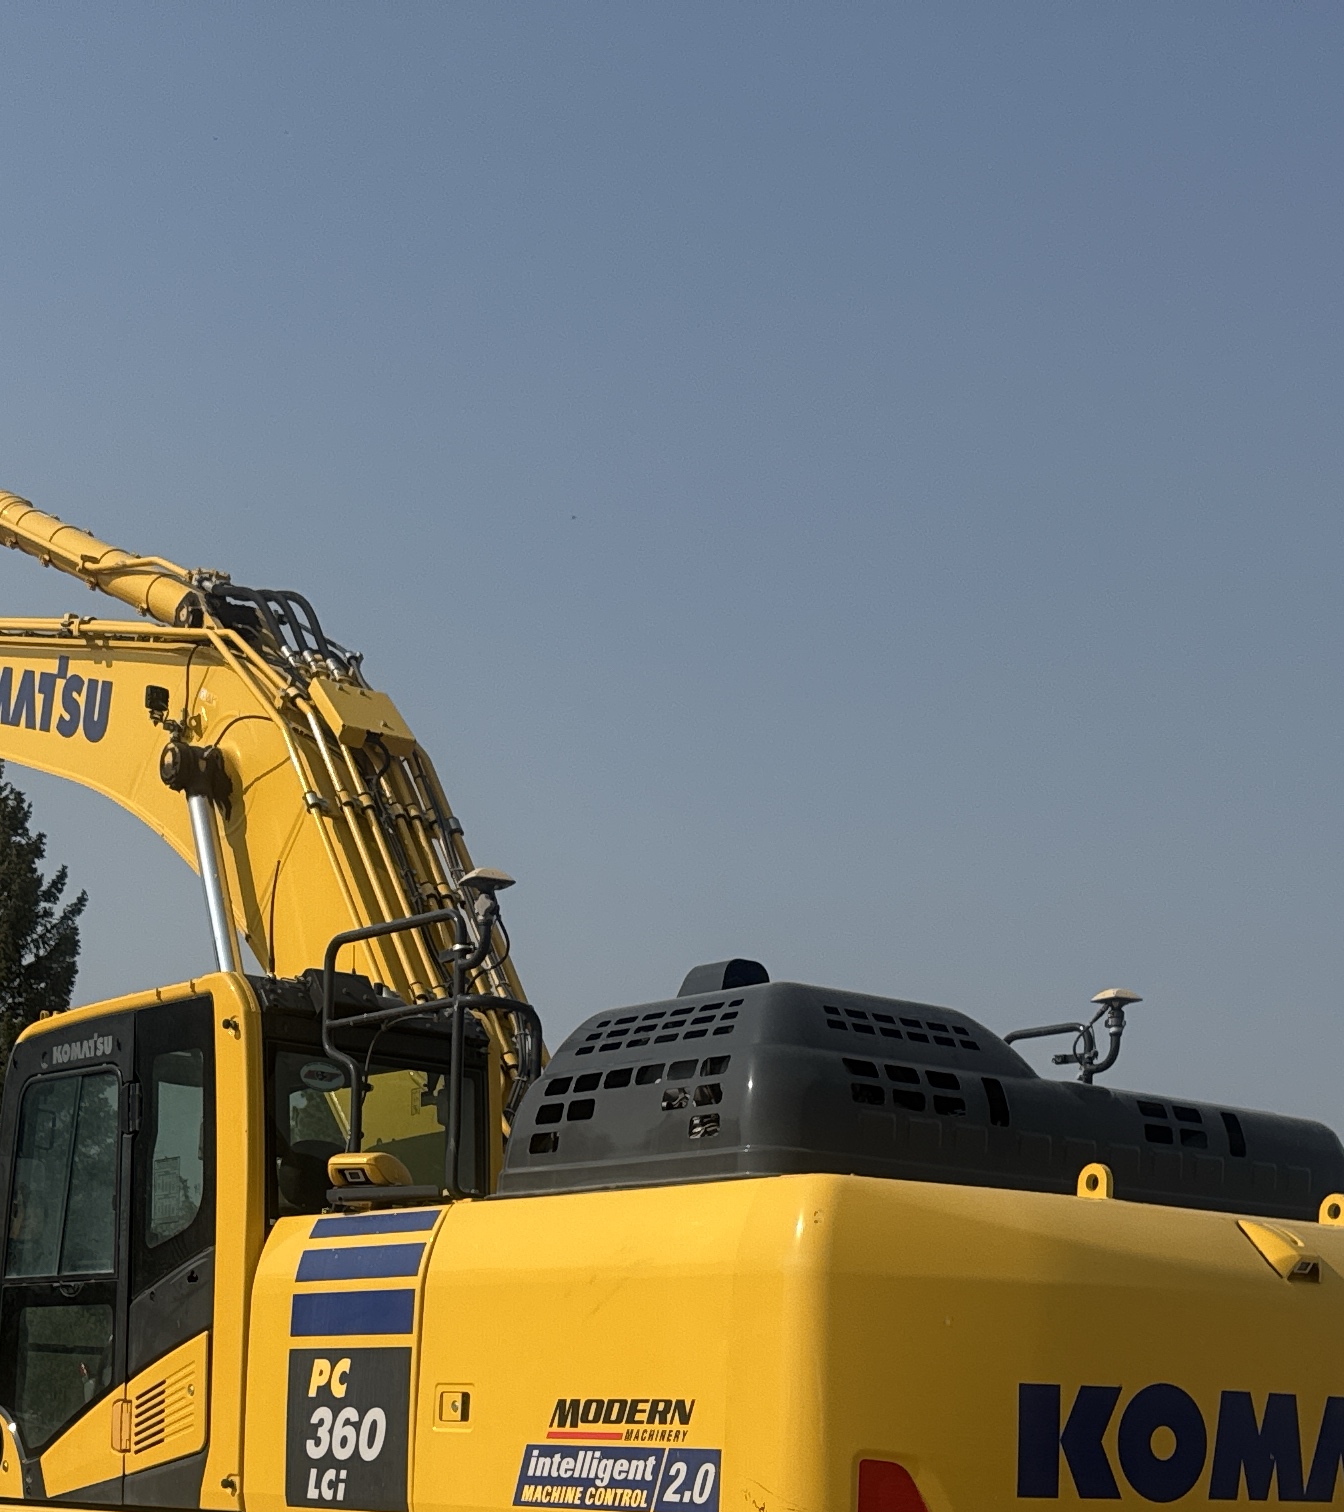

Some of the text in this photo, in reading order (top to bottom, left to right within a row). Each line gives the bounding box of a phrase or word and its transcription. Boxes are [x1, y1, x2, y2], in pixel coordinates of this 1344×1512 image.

[52, 1032, 113, 1065] KOMATSU
[308, 1358, 352, 1399] PC
[549, 1398, 696, 1429] MODERN
[306, 1406, 387, 1462] 360
[624, 1428, 689, 1443] MACHINERY
[307, 1467, 348, 1502] LCi
[527, 1449, 656, 1487] intelligent
[663, 1461, 716, 1504] 2.0
[521, 1484, 648, 1508] MACHINE CONTROL
